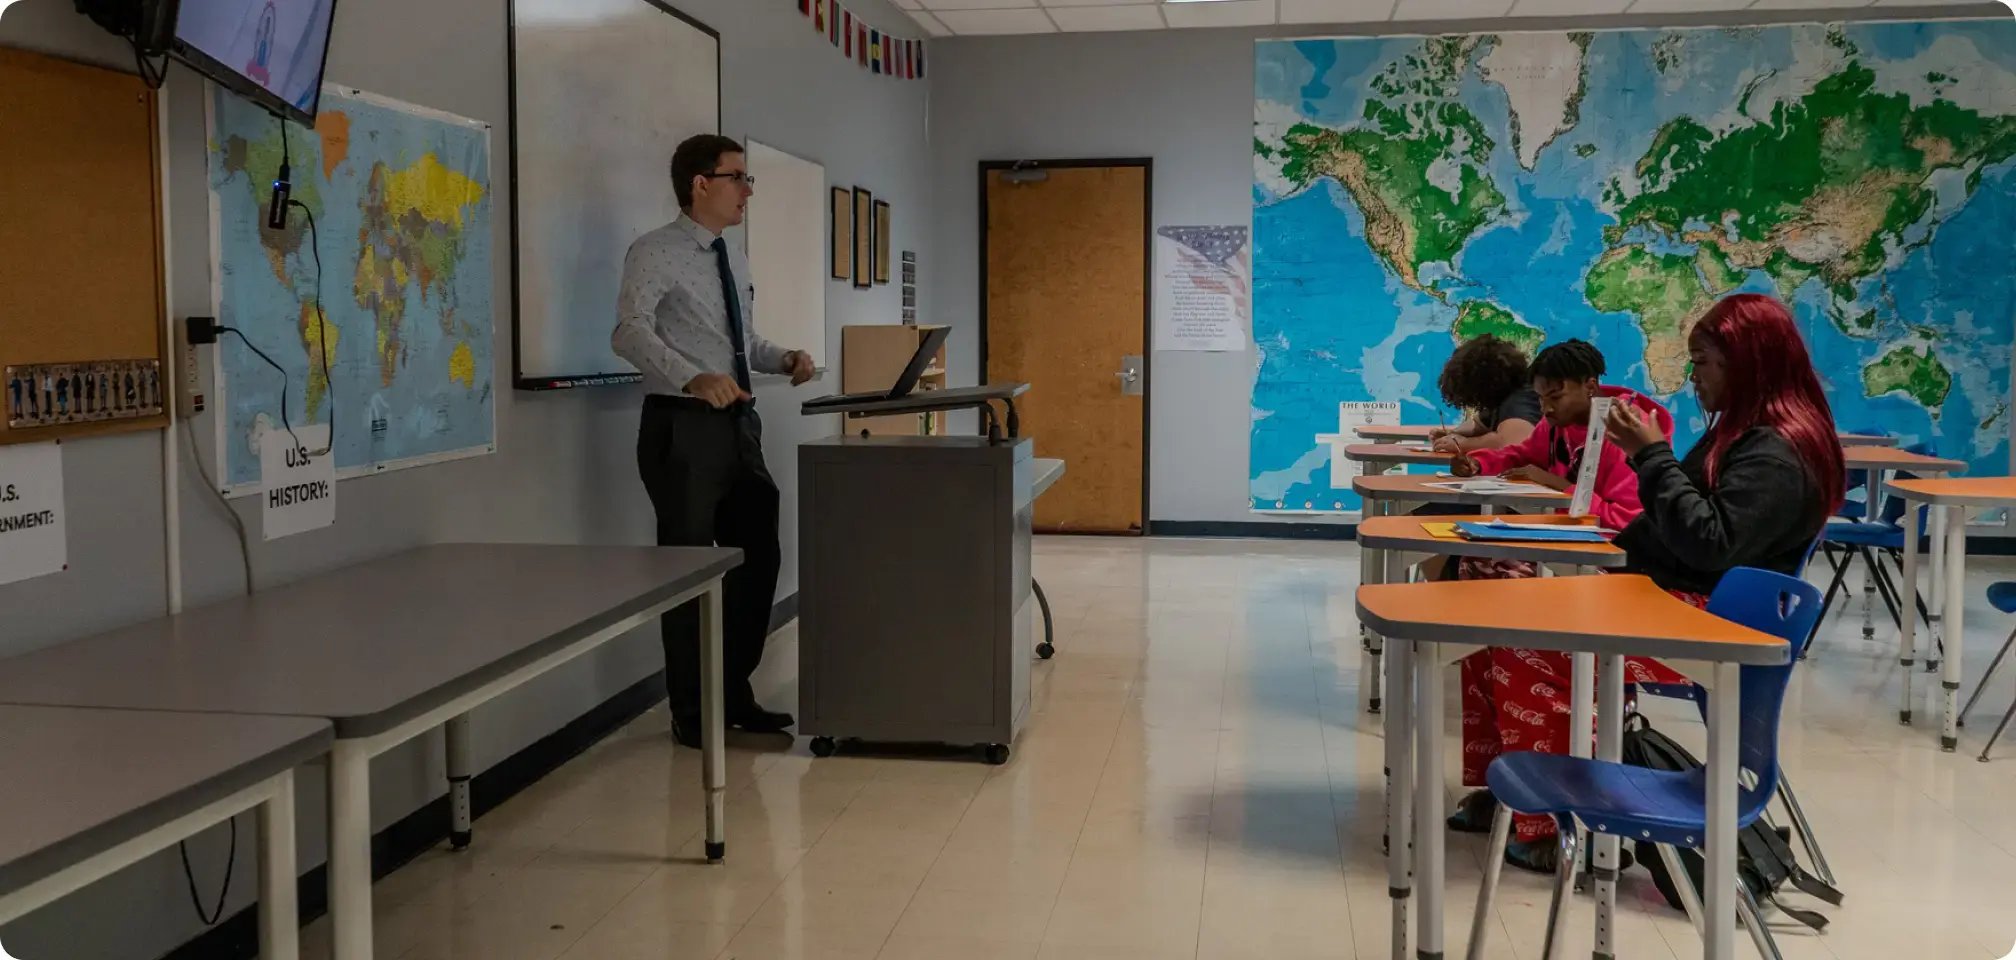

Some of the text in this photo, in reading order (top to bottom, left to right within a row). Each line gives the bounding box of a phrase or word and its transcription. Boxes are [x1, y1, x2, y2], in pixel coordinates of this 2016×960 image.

[285, 446, 311, 468] U.S.
[0, 484, 20, 503] .S.
[269, 480, 329, 508] HISTORY:
